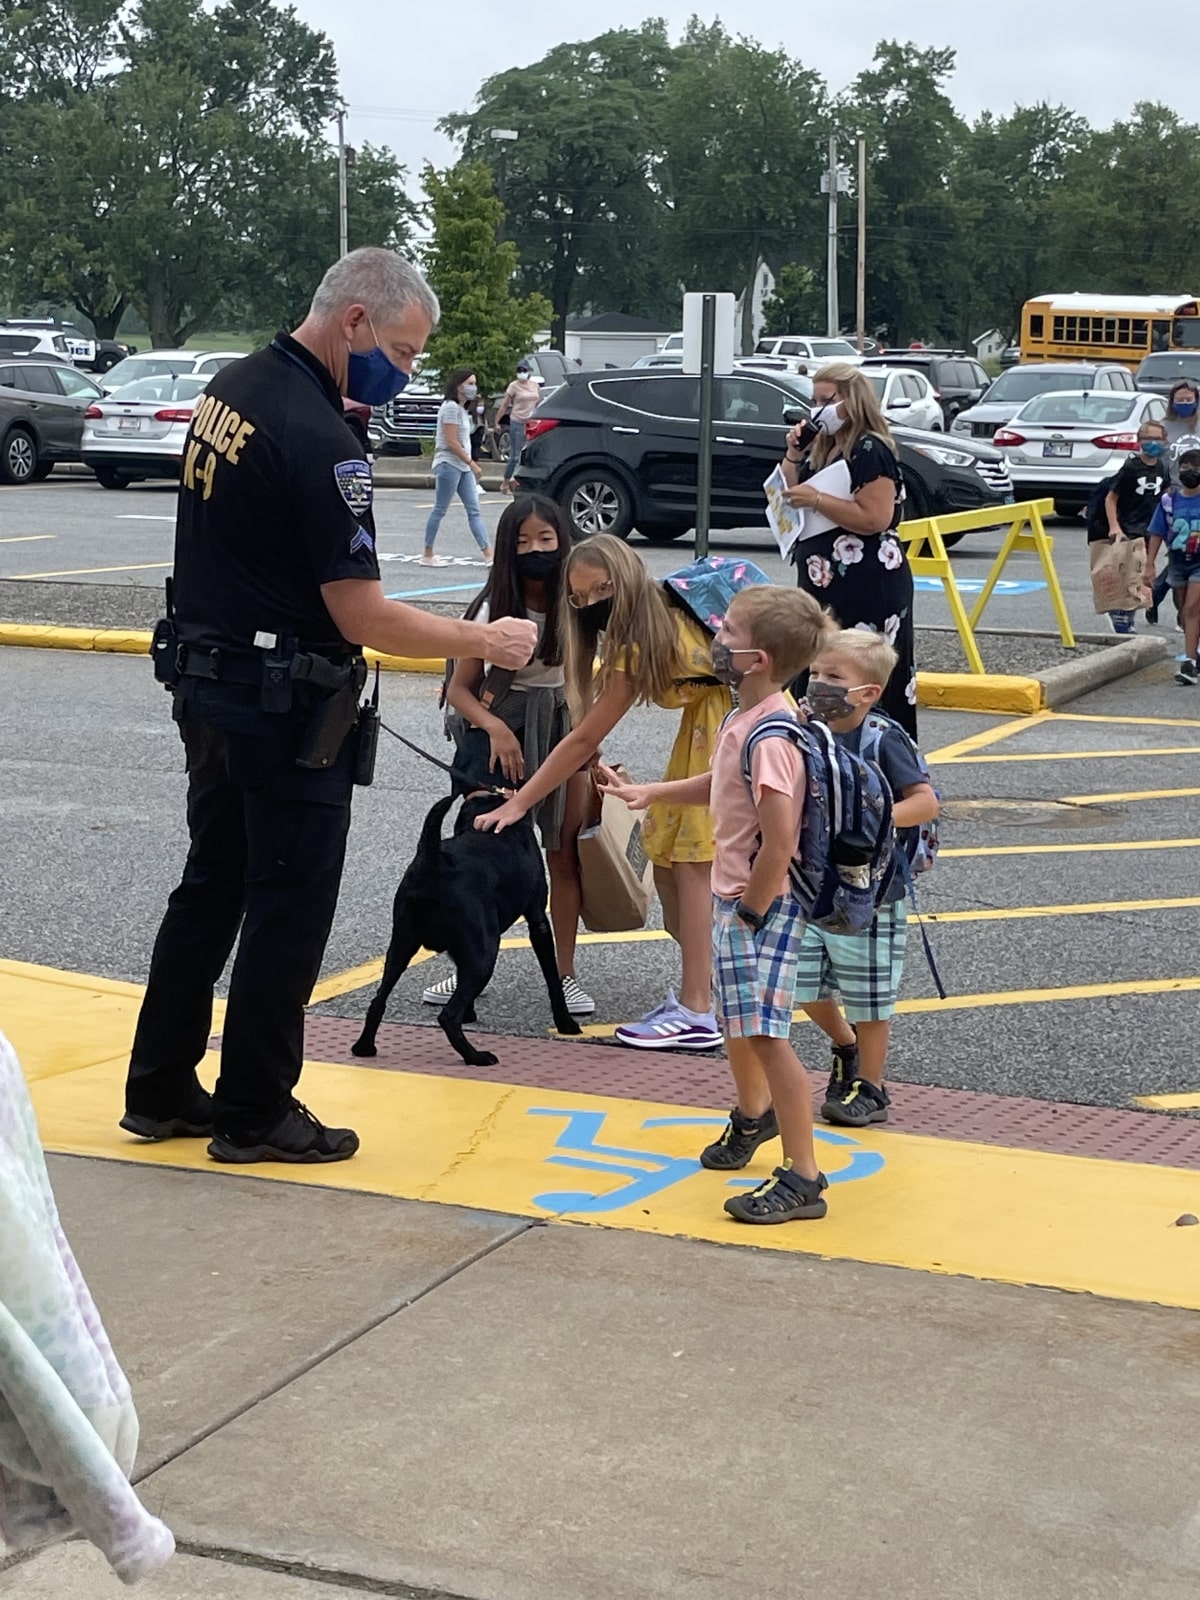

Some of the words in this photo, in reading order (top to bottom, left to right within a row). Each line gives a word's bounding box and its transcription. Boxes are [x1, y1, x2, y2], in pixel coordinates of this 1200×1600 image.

[70, 347, 91, 355] ICE
[193, 392, 256, 465] POLICE
[183, 440, 217, 500] K-9
